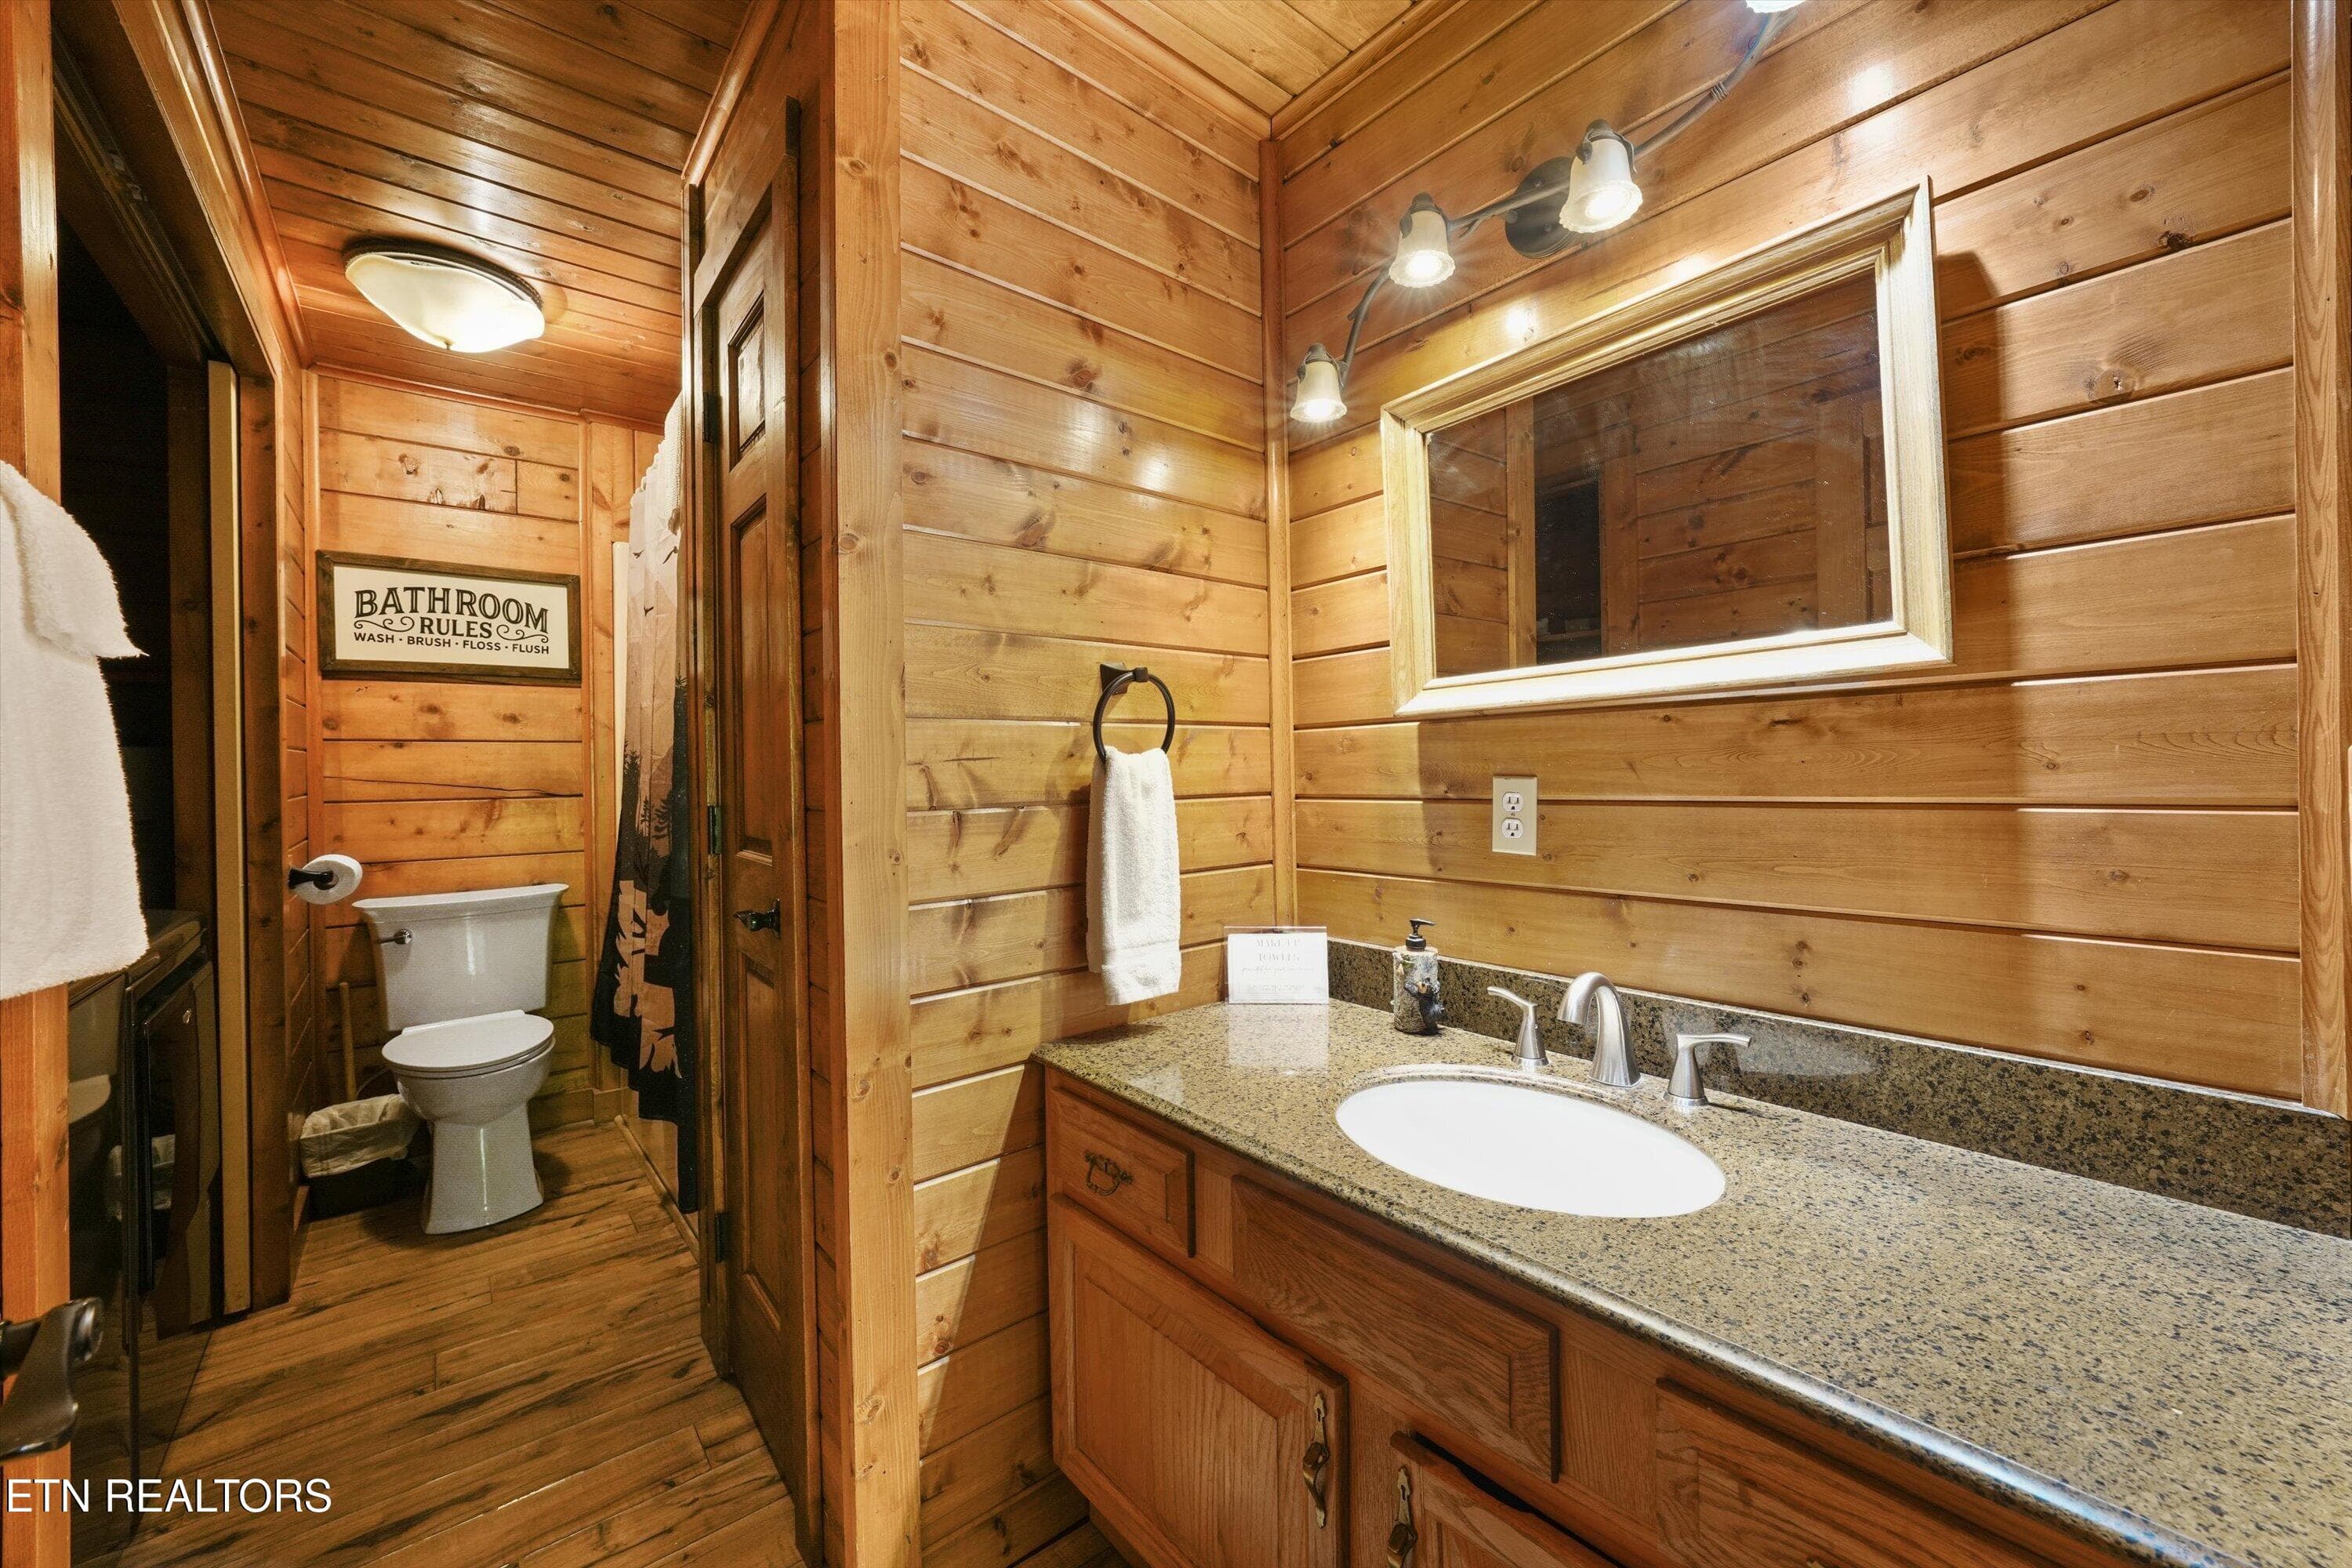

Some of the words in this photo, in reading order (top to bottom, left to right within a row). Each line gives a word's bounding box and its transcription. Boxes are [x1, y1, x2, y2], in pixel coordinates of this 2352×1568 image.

[354, 586, 549, 633] BATHROOM
[419, 617, 492, 639] RULES
[354, 632, 394, 644] WASH
[407, 636, 451, 648] BRUSH
[463, 640, 501, 652] FLOSS
[513, 644, 549, 655] FLUSH
